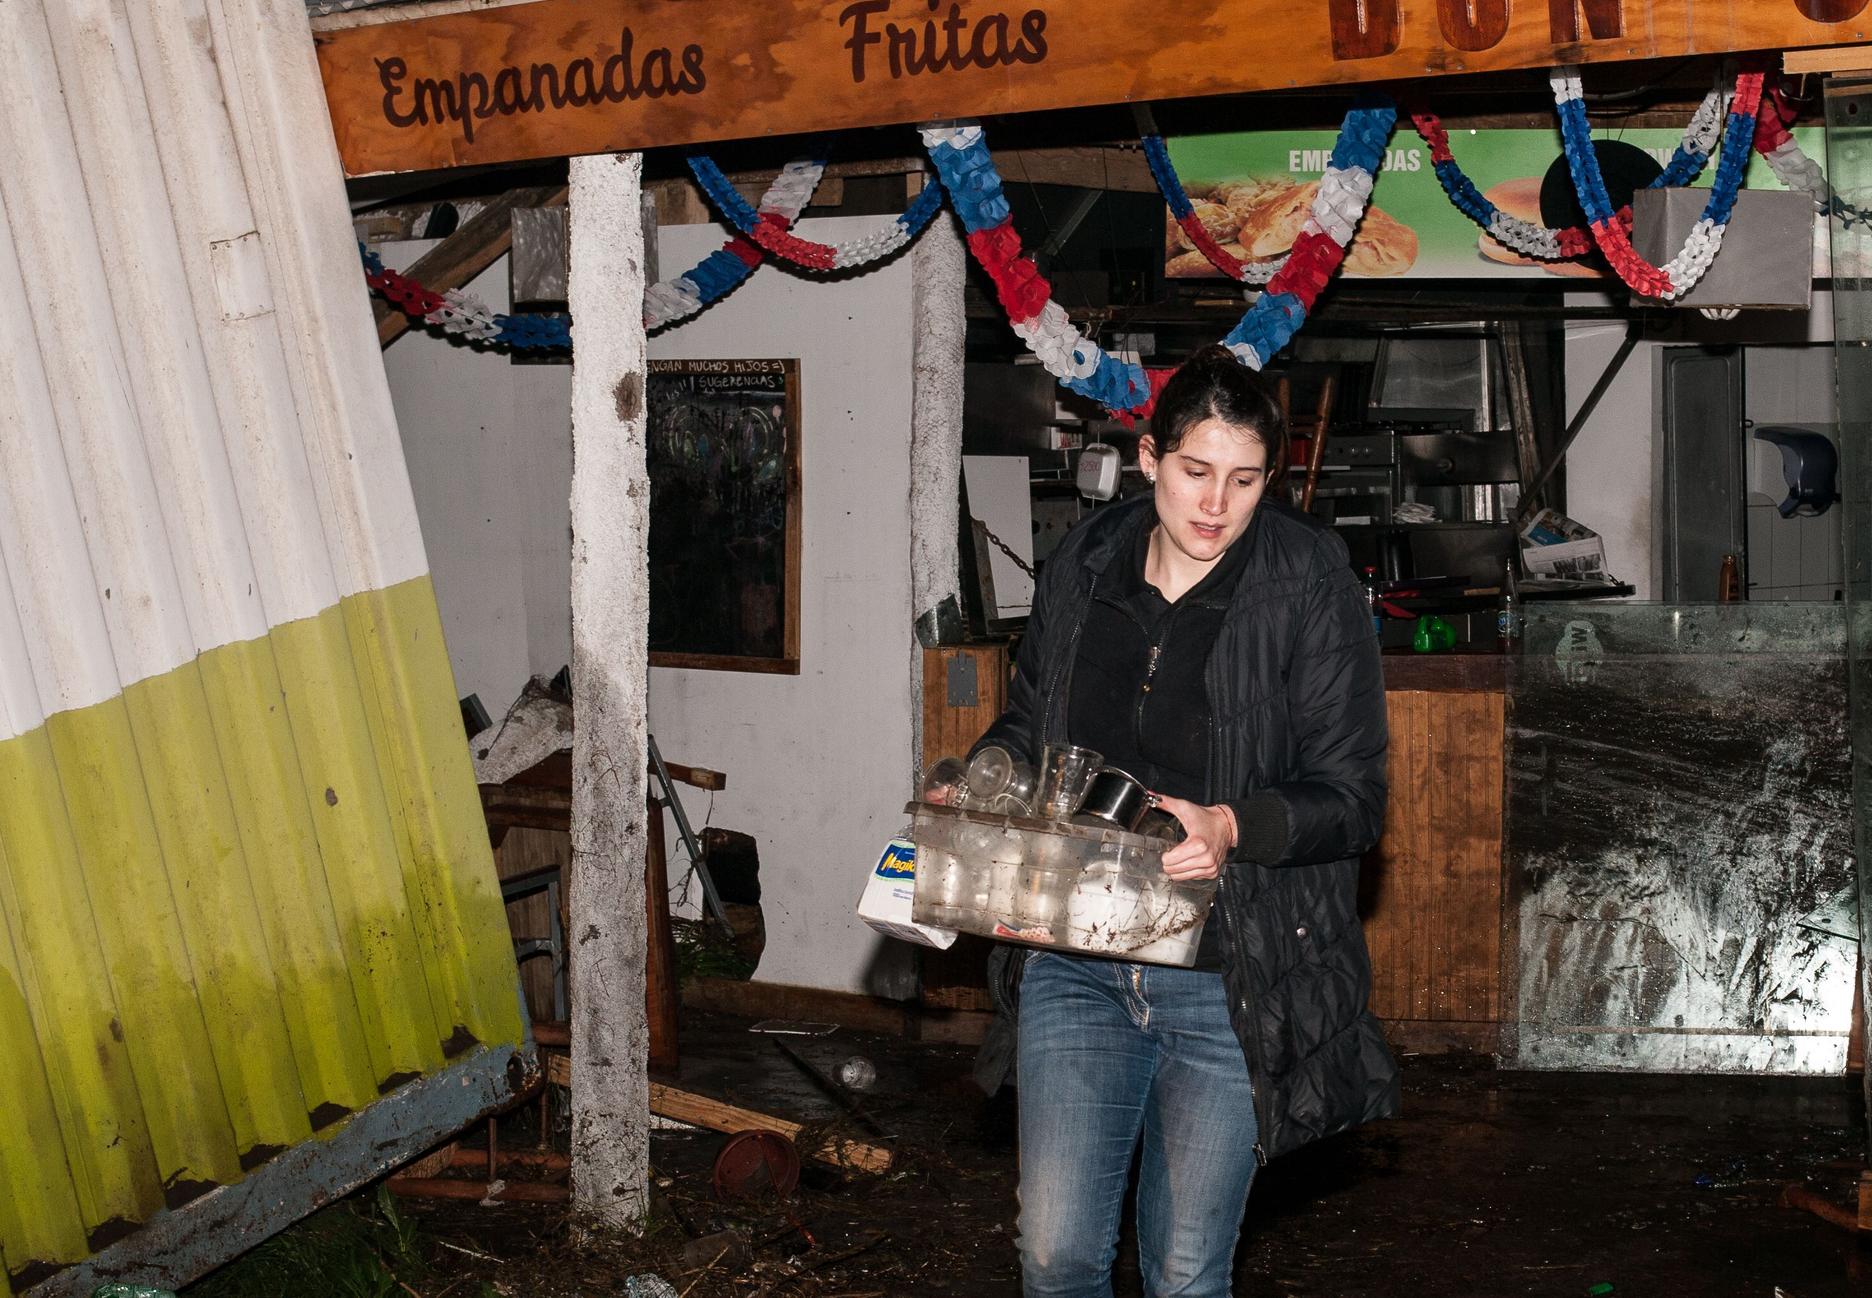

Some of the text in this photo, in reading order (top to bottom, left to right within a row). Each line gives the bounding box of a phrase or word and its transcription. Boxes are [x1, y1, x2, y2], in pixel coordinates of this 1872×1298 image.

[374, 0, 1048, 144] Empanadas Fritas
[1289, 149, 1421, 171] EMPDAS
[689, 361, 729, 373] MUCHOS
